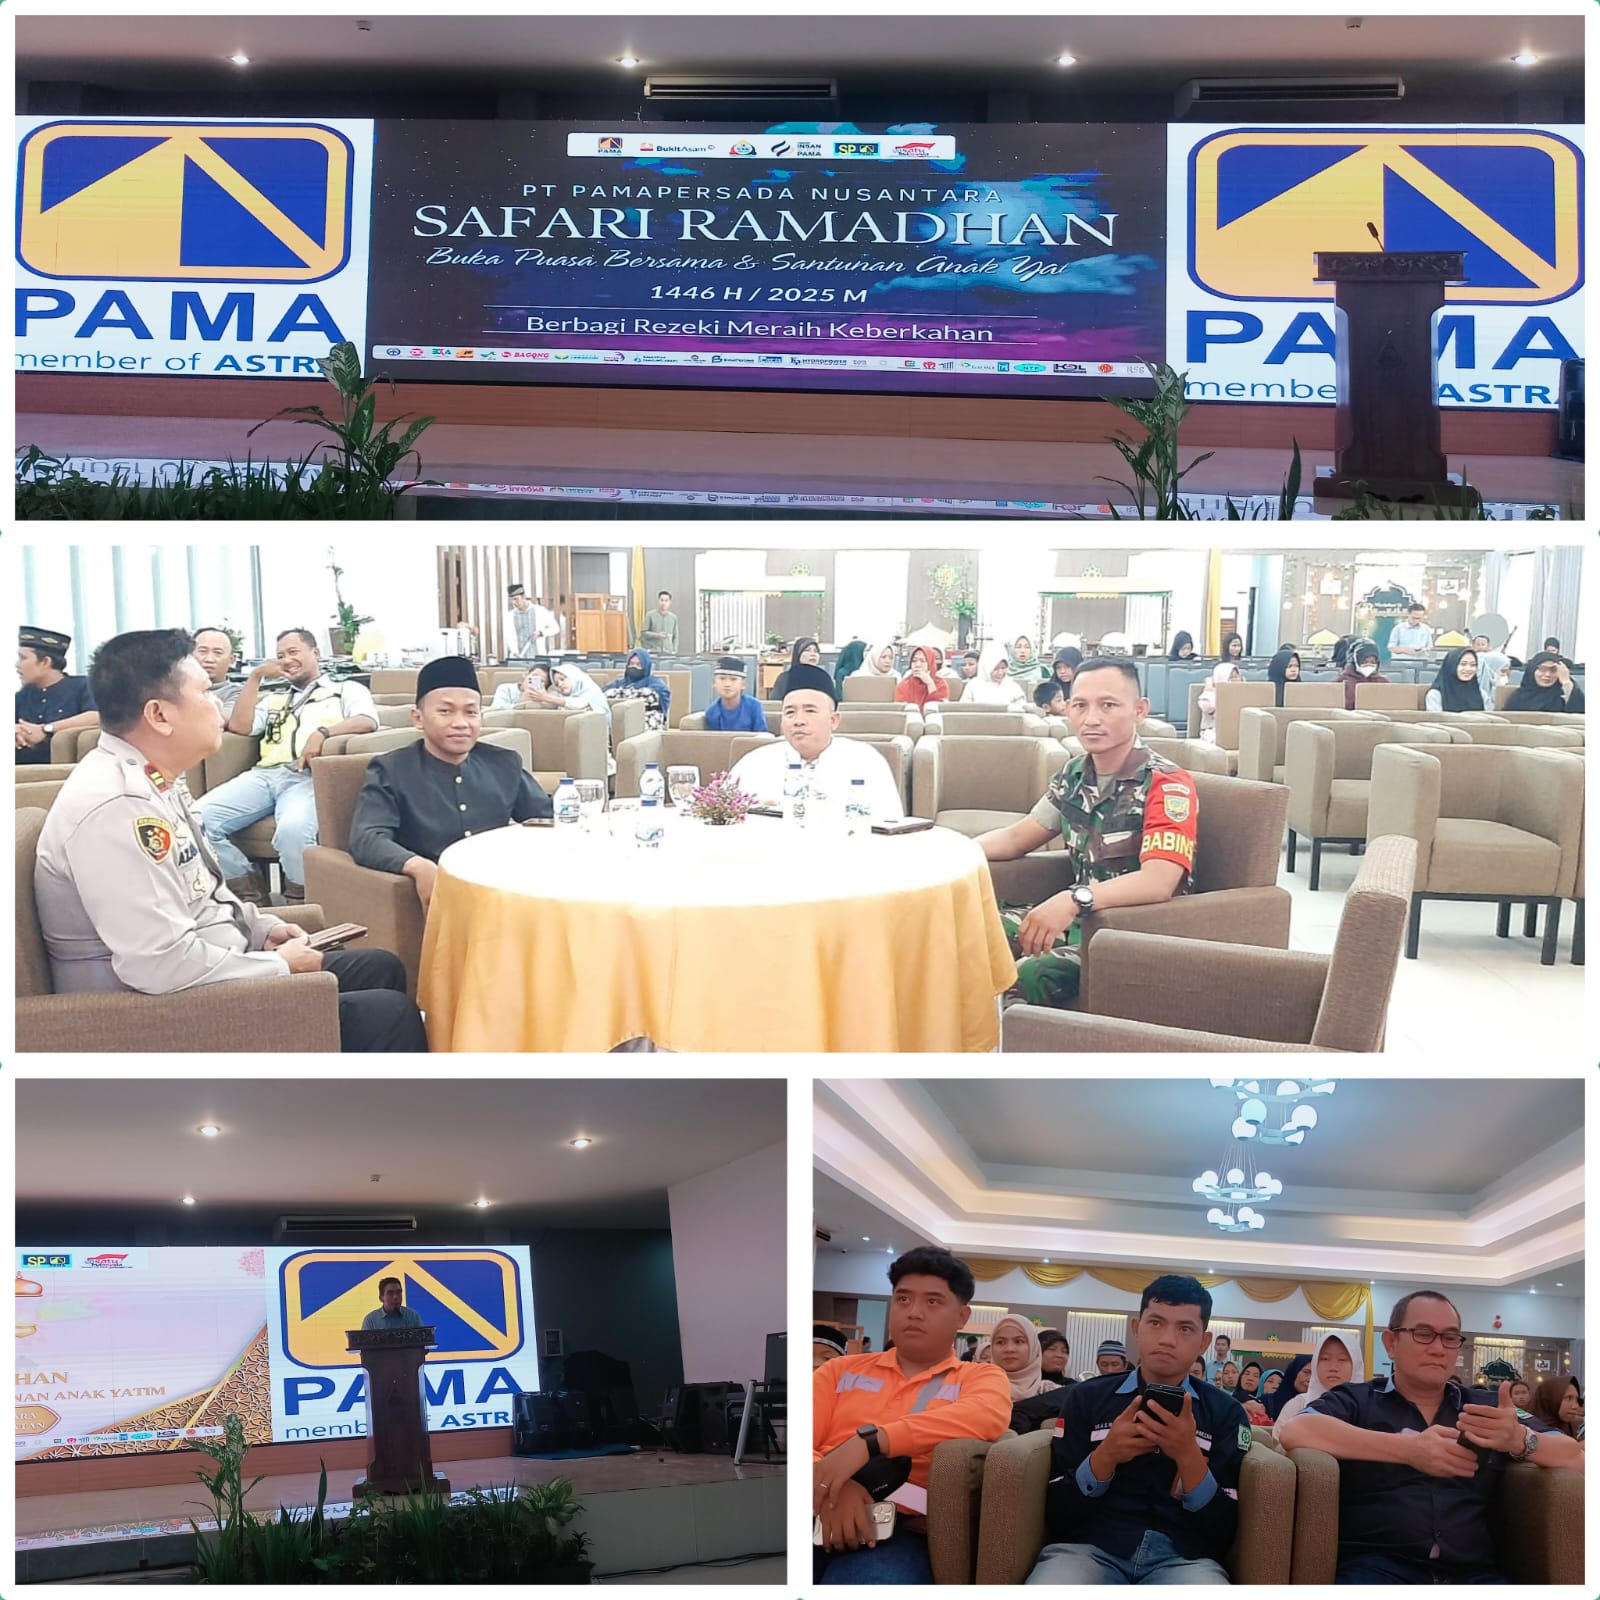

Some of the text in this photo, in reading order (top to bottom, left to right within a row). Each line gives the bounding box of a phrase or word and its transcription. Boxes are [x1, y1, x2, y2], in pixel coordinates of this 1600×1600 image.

[839, 145, 856, 154] SP
[523, 185, 1002, 203] PT PAMAPERSADA NUSANTARA
[413, 205, 1119, 247] SAFARI RAMADHAN
[426, 246, 504, 266] Buka
[514, 248, 598, 268] Puasa
[604, 249, 727, 270] Bersama
[733, 254, 759, 270] &
[771, 253, 905, 273] Santunan
[916, 255, 1001, 274] Anak
[651, 285, 868, 303] 1446 H / 2025 M
[15, 288, 346, 343] PAMA
[527, 316, 993, 342] Berbagi Rezeki Meraih Keberkahan
[15, 350, 324, 374] member of ASTR
[1439, 383, 1559, 404] ASTR
[27, 1256, 47, 1267] SP
[54, 1389, 105, 1401] ANAK
[110, 1386, 166, 1398] YATIM
[440, 1411, 513, 1428] ASTR
